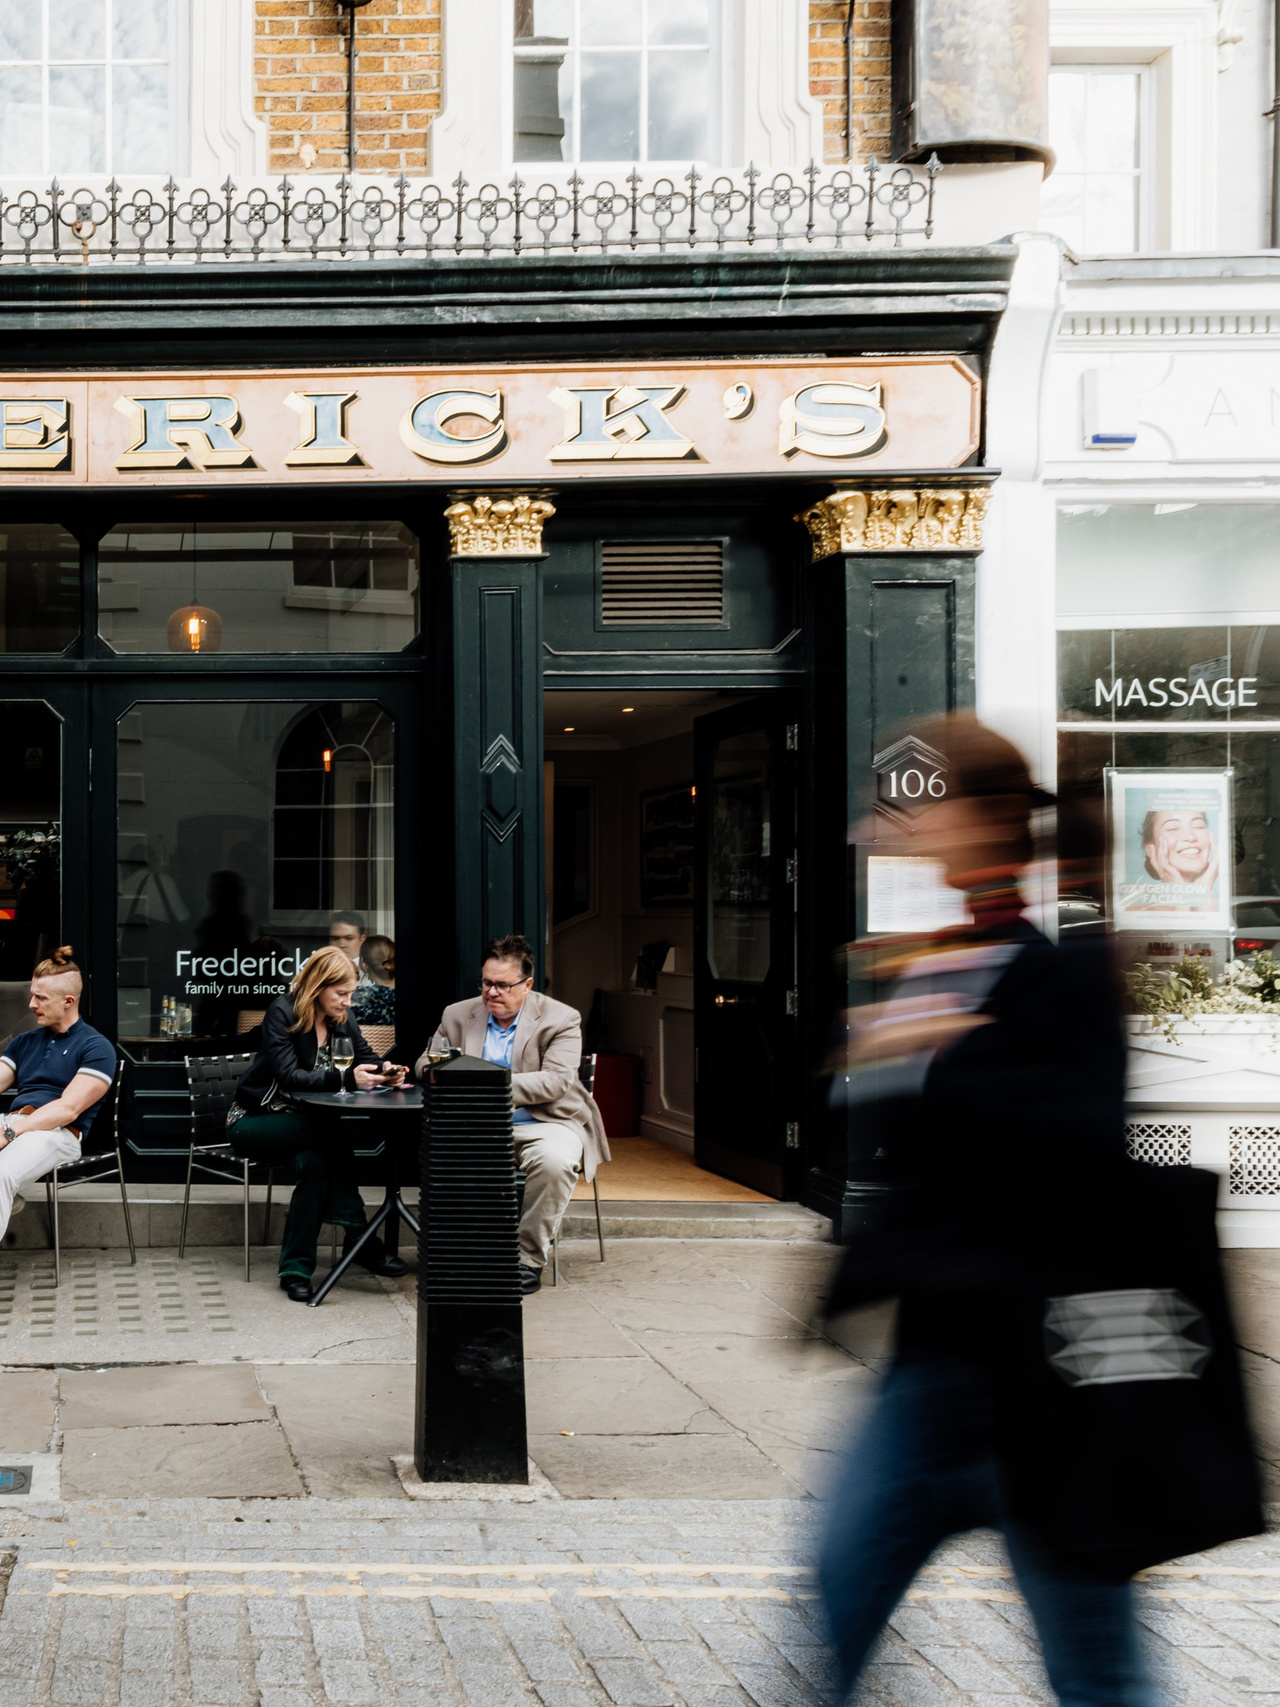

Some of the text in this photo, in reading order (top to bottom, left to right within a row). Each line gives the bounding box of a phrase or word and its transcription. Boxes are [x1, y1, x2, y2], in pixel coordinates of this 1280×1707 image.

[1095, 677, 1258, 707] MASSAGE
[889, 769, 946, 798] 106
[1120, 884, 1208, 894] OXYGEN GLOW
[1143, 894, 1185, 904] FACIAL
[185, 981, 224, 998] family
[227, 983, 250, 994] run
[252, 981, 286, 994] since
